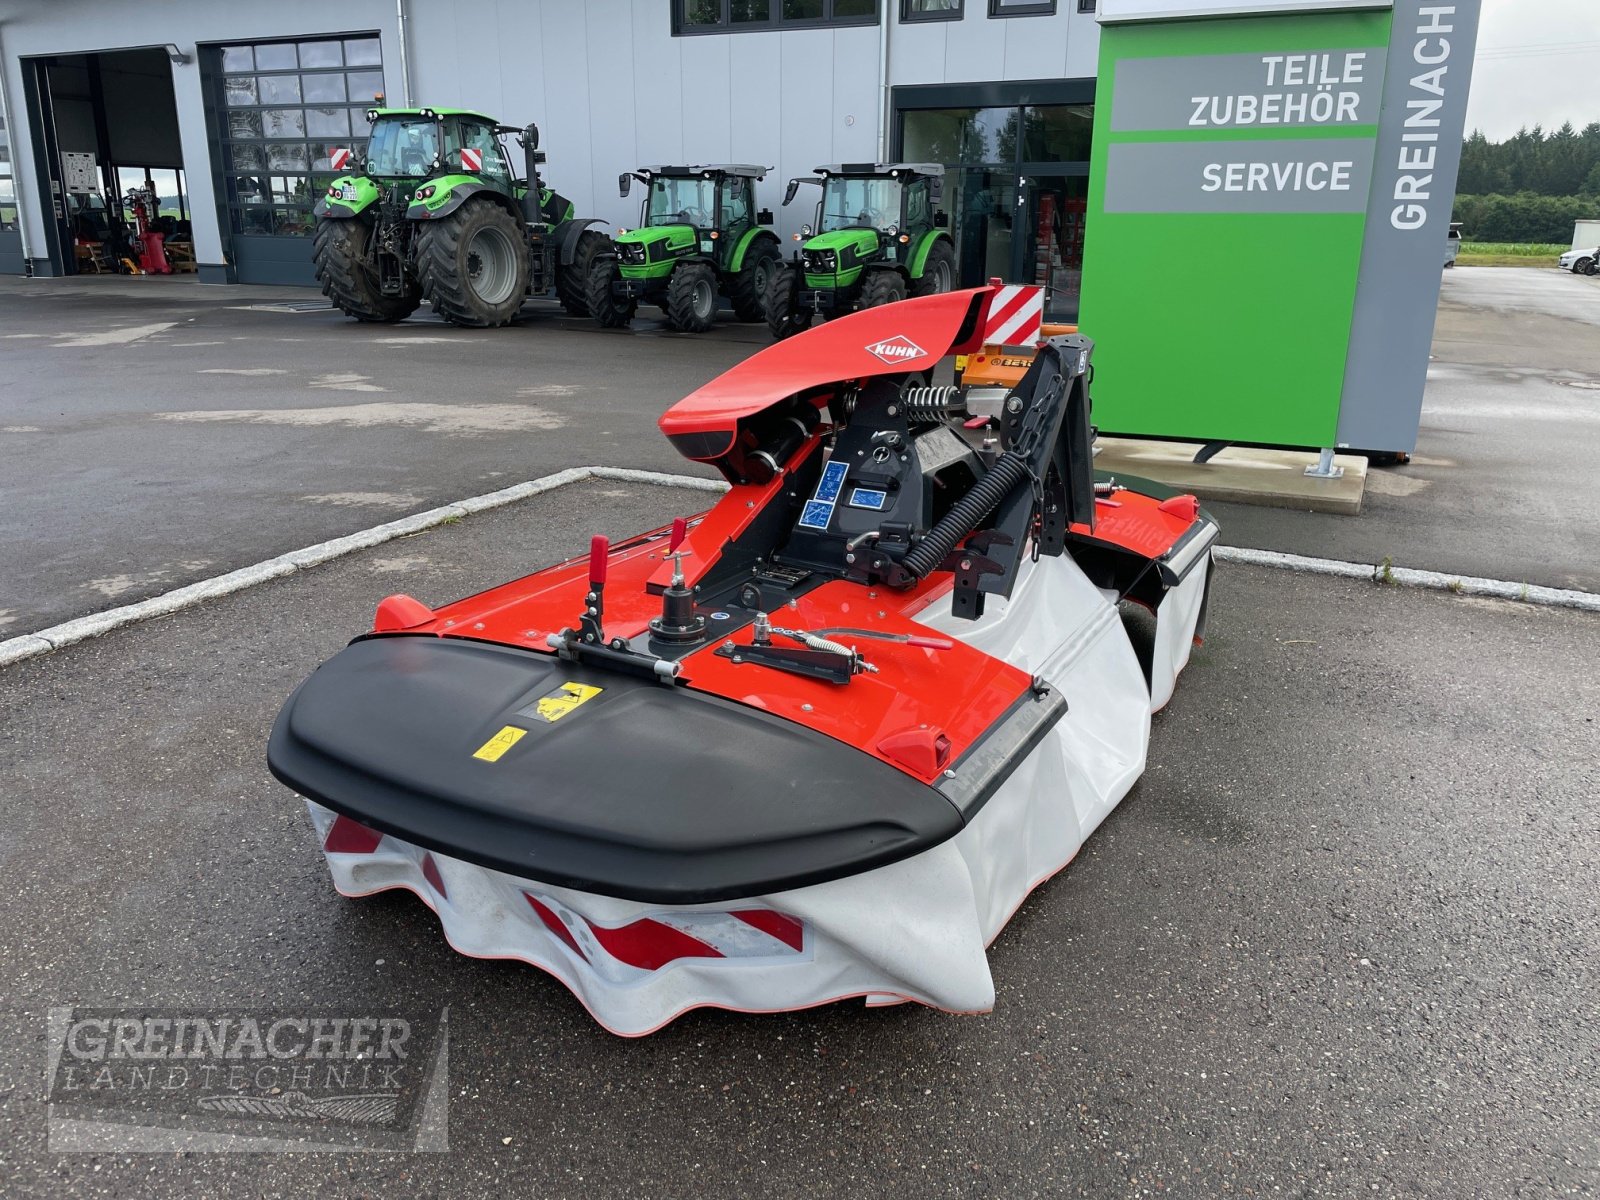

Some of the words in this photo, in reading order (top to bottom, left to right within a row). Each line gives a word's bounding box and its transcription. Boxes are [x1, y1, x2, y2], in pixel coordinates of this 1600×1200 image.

[1262, 52, 1367, 86] TEILE
[1188, 84, 1360, 126] ZUBEHÖR
[1390, 6, 1456, 231] GREINACH
[1200, 161, 1354, 193] SERVICE
[874, 344, 918, 358] KUHN
